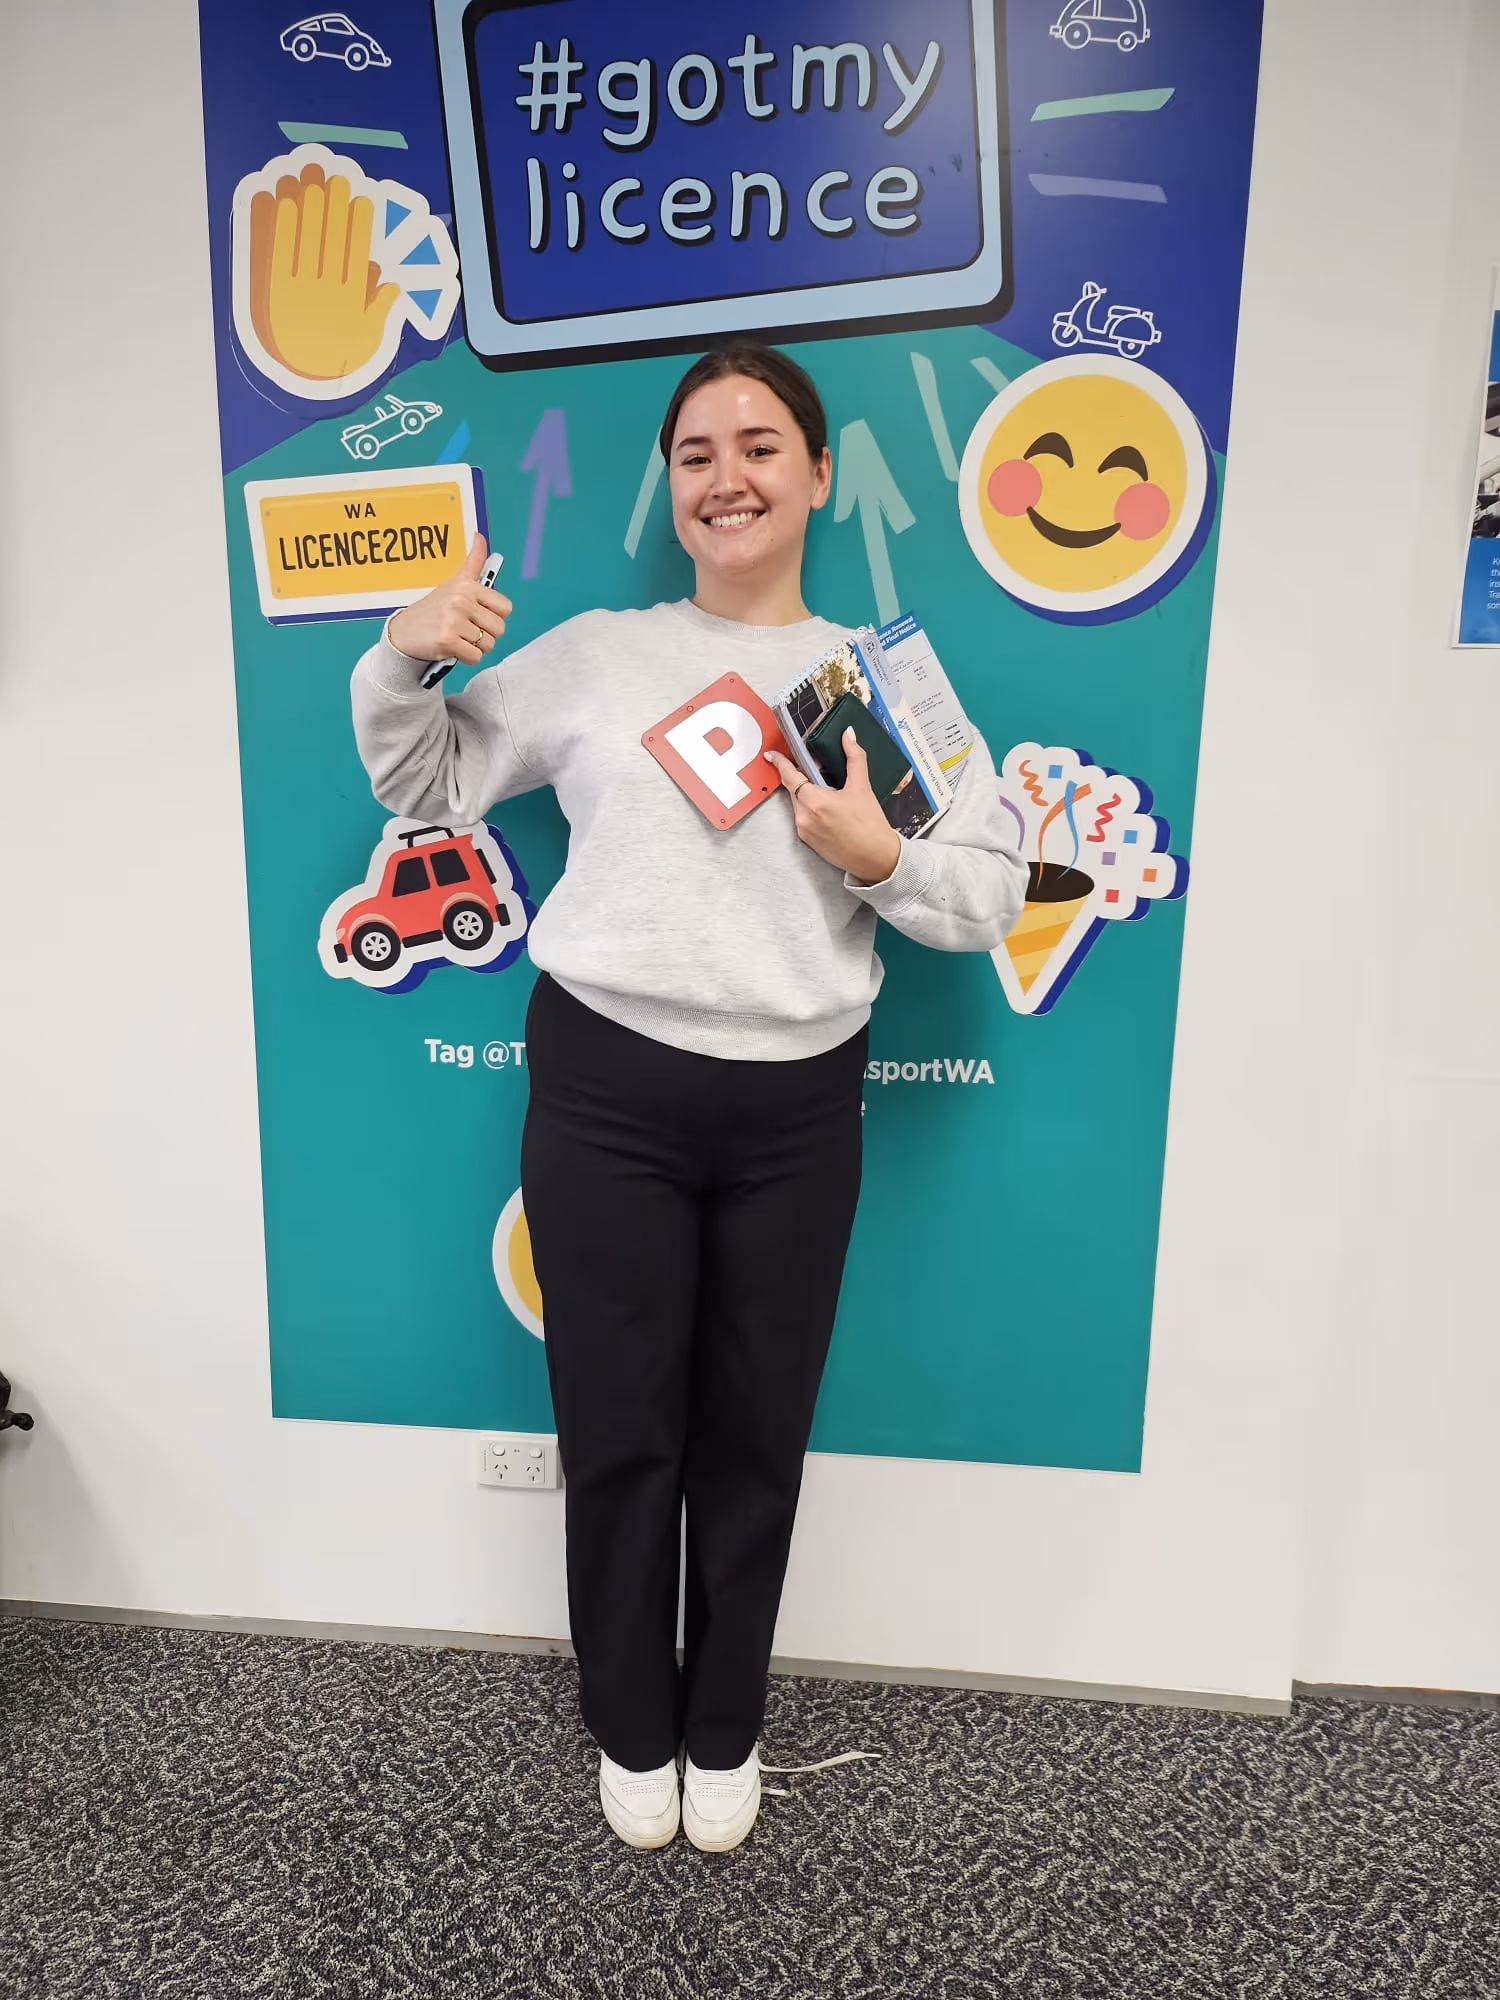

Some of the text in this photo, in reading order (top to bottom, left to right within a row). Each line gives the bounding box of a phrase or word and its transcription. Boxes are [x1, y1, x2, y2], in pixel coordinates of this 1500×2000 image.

[515, 33, 942, 147] #gotmy
[526, 157, 920, 251] licence
[344, 502, 377, 520] WA
[279, 524, 450, 571] LICENCE2DRV
[886, 631, 900, 644] Final
[898, 622, 917, 636] Notice
[891, 615, 914, 632] Renewal
[664, 701, 763, 810] P
[424, 1038, 474, 1068] Tag
